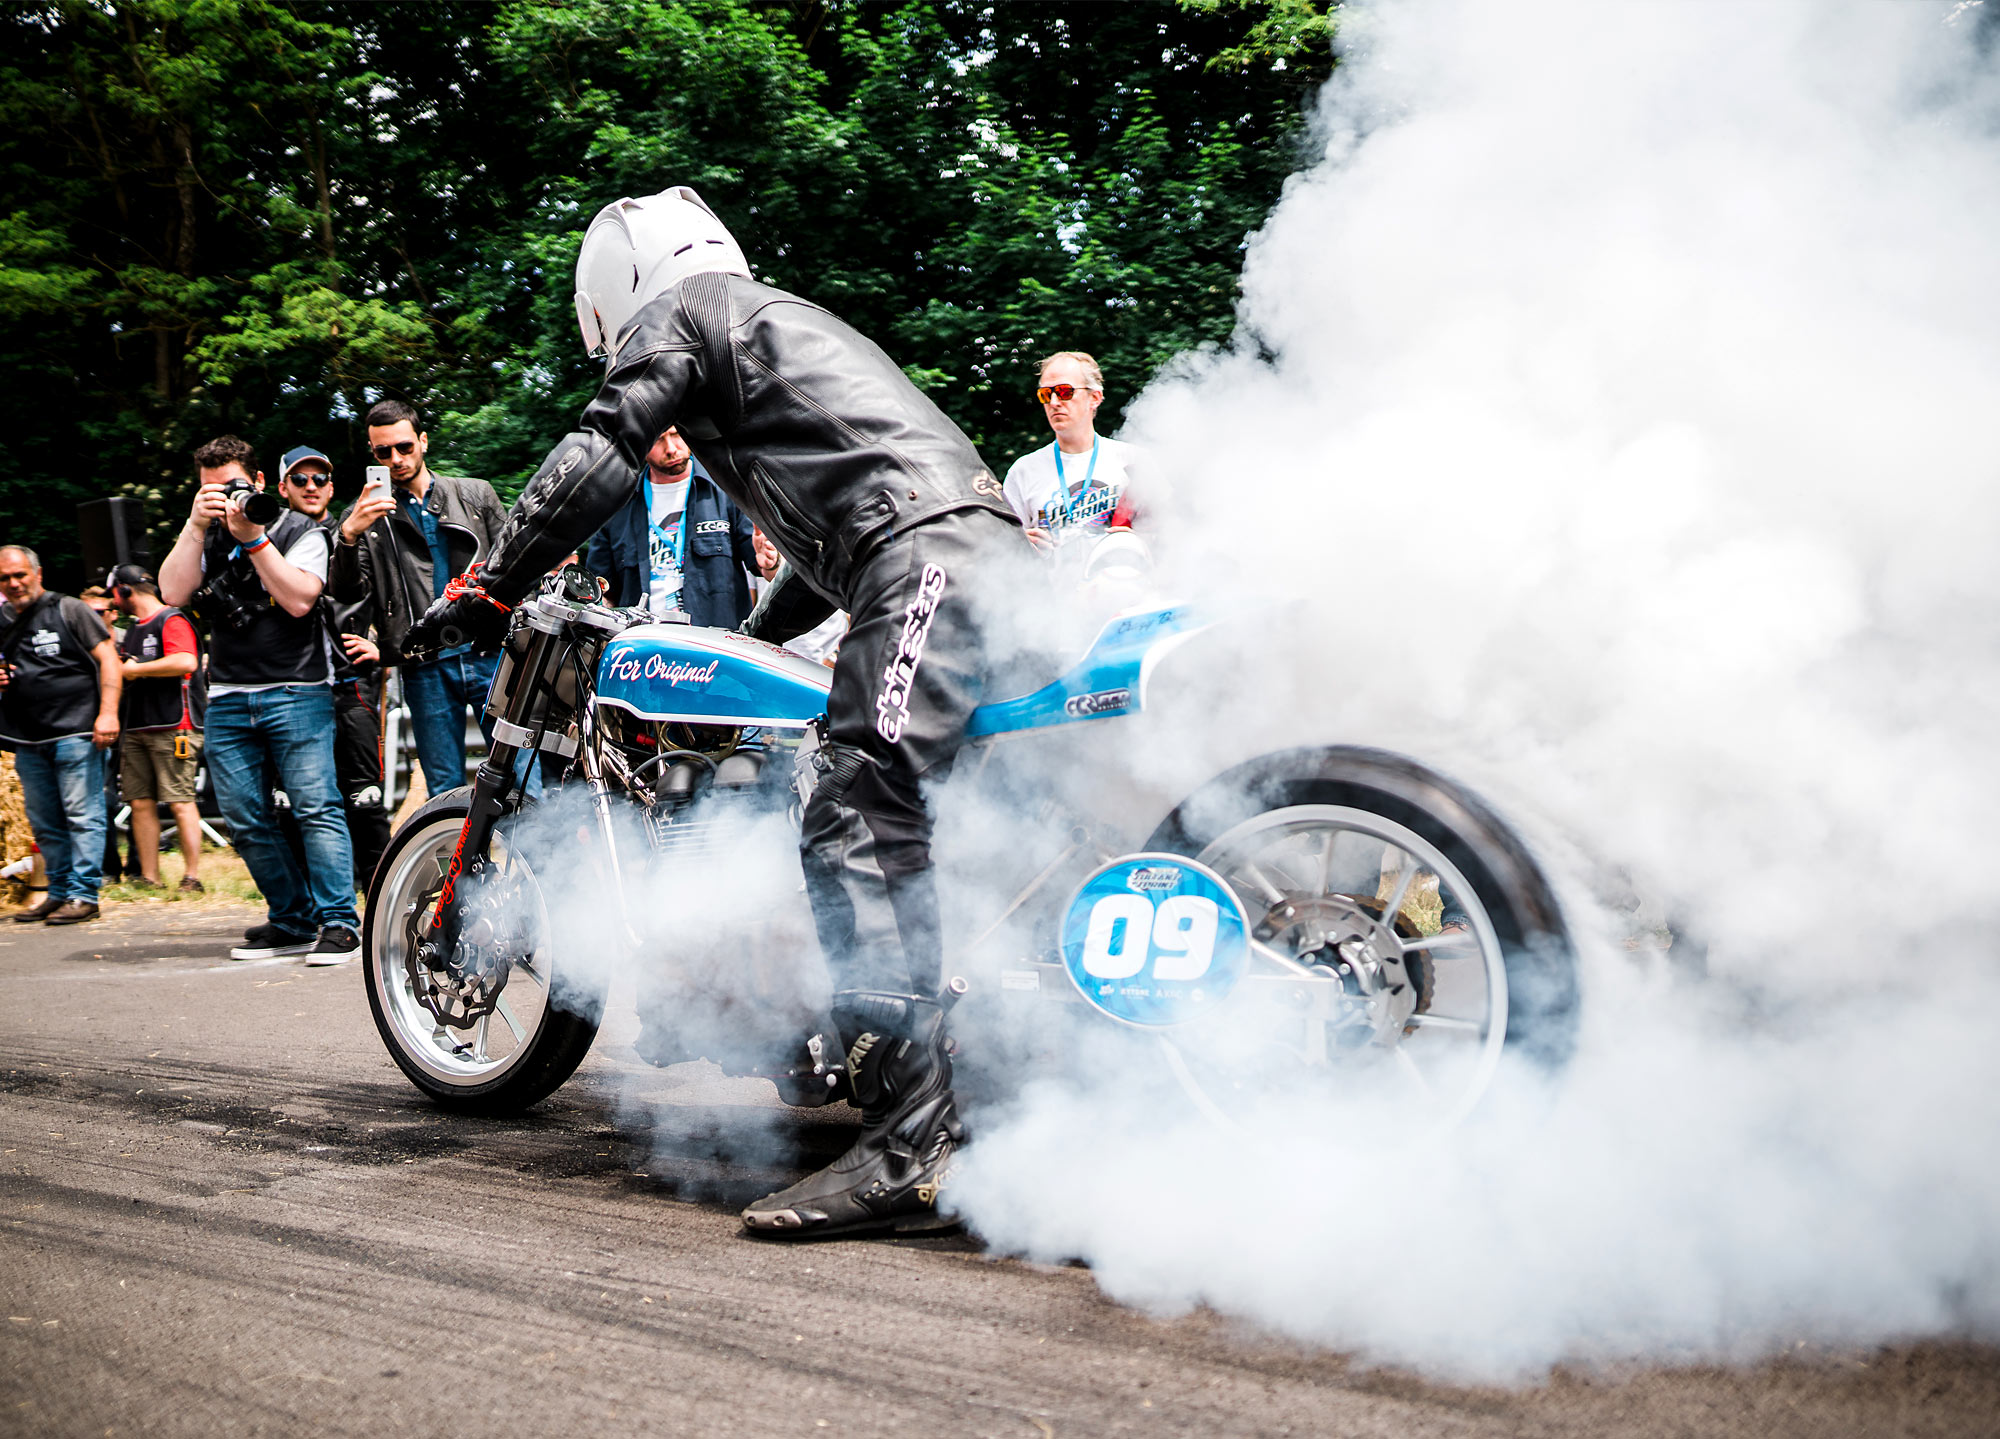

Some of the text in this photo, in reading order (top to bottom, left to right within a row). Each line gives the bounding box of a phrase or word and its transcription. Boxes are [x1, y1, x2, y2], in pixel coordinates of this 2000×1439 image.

[608, 646, 719, 687] Fcr Original
[876, 562, 947, 744] alpinestars
[1082, 893, 1219, 981] 09
